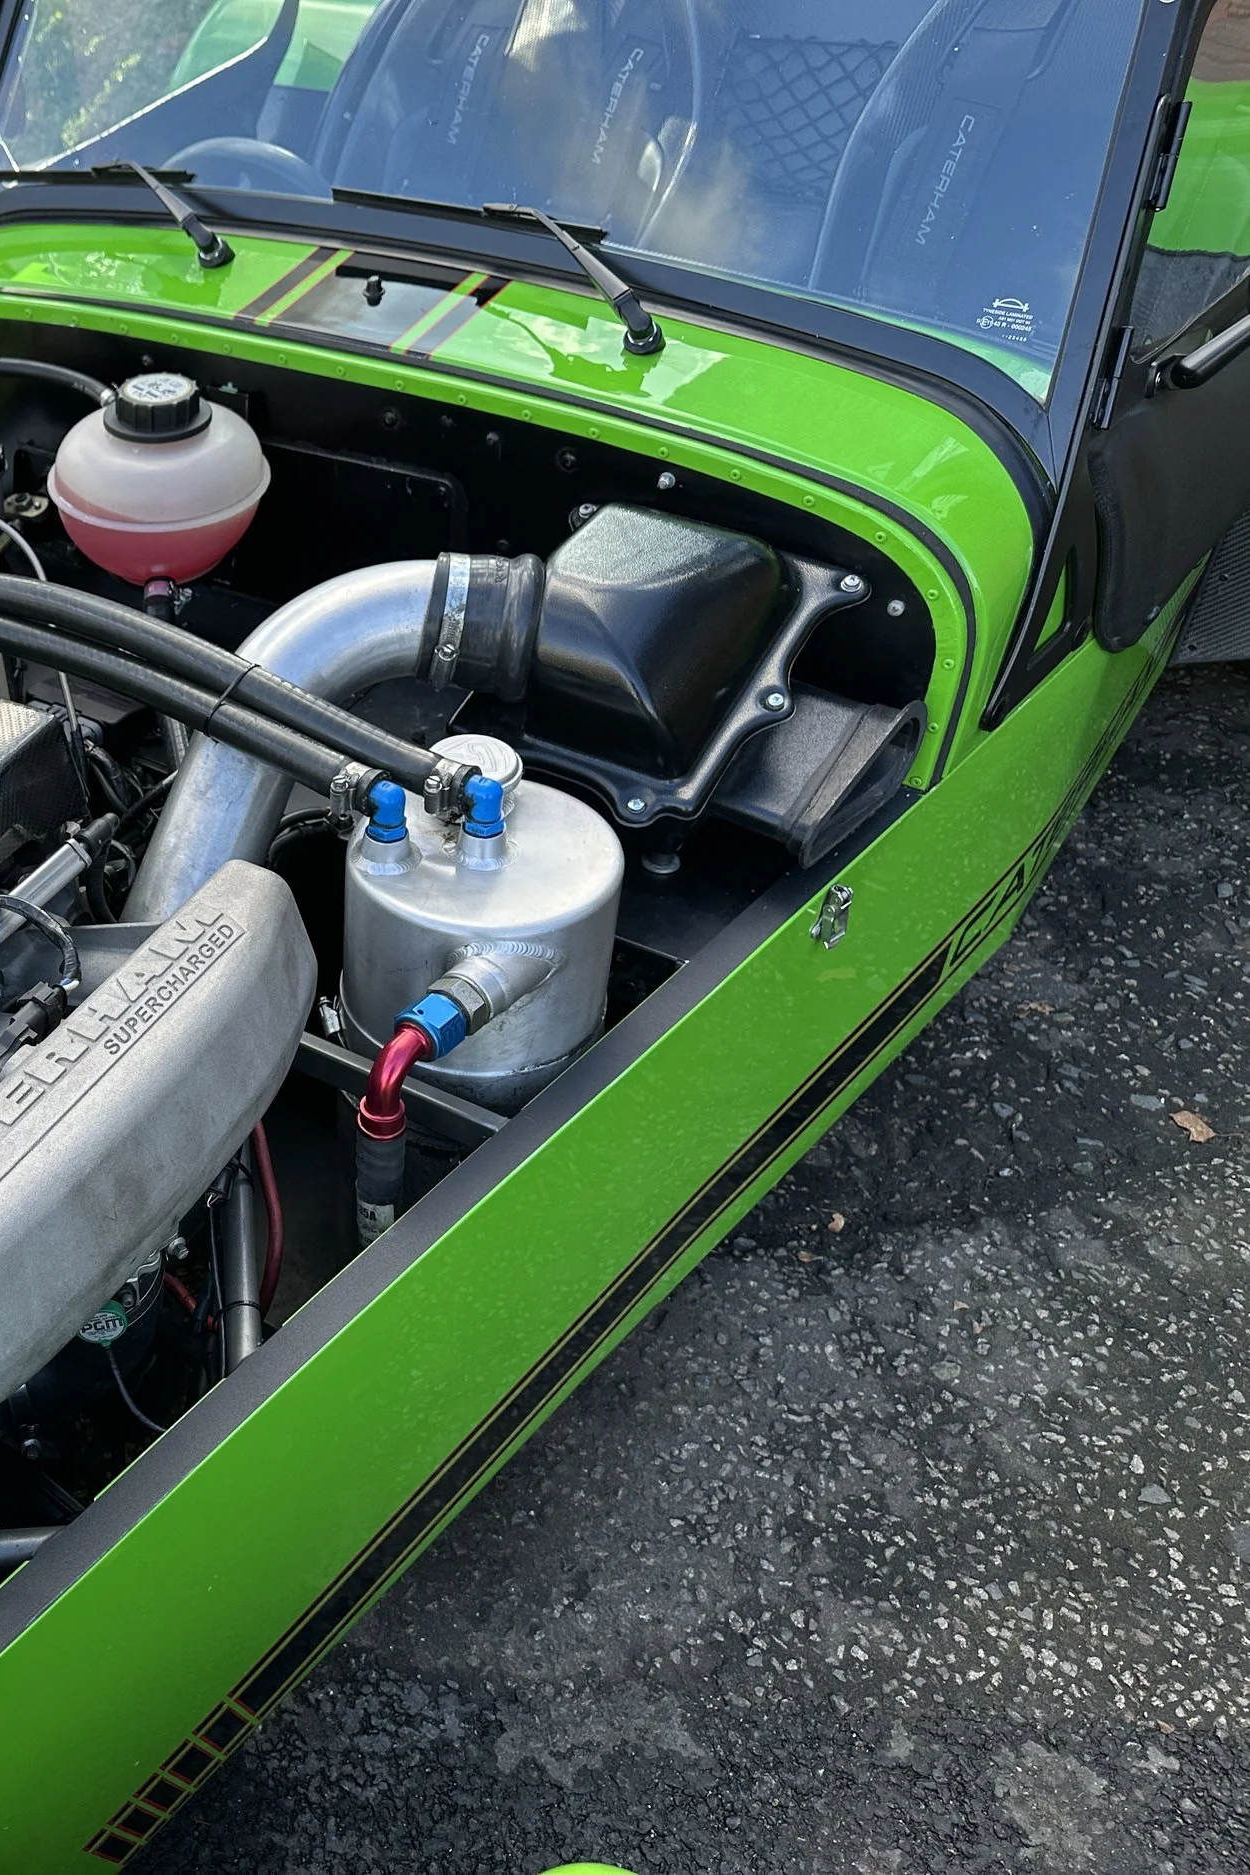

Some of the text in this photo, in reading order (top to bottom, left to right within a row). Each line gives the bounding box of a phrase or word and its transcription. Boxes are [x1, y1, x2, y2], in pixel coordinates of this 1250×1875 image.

[447, 33, 490, 145] CATERHAM
[591, 47, 644, 164] CATERHAM
[915, 114, 975, 245] CATERHAM
[103, 924, 235, 1056] SUPERCHARGED
